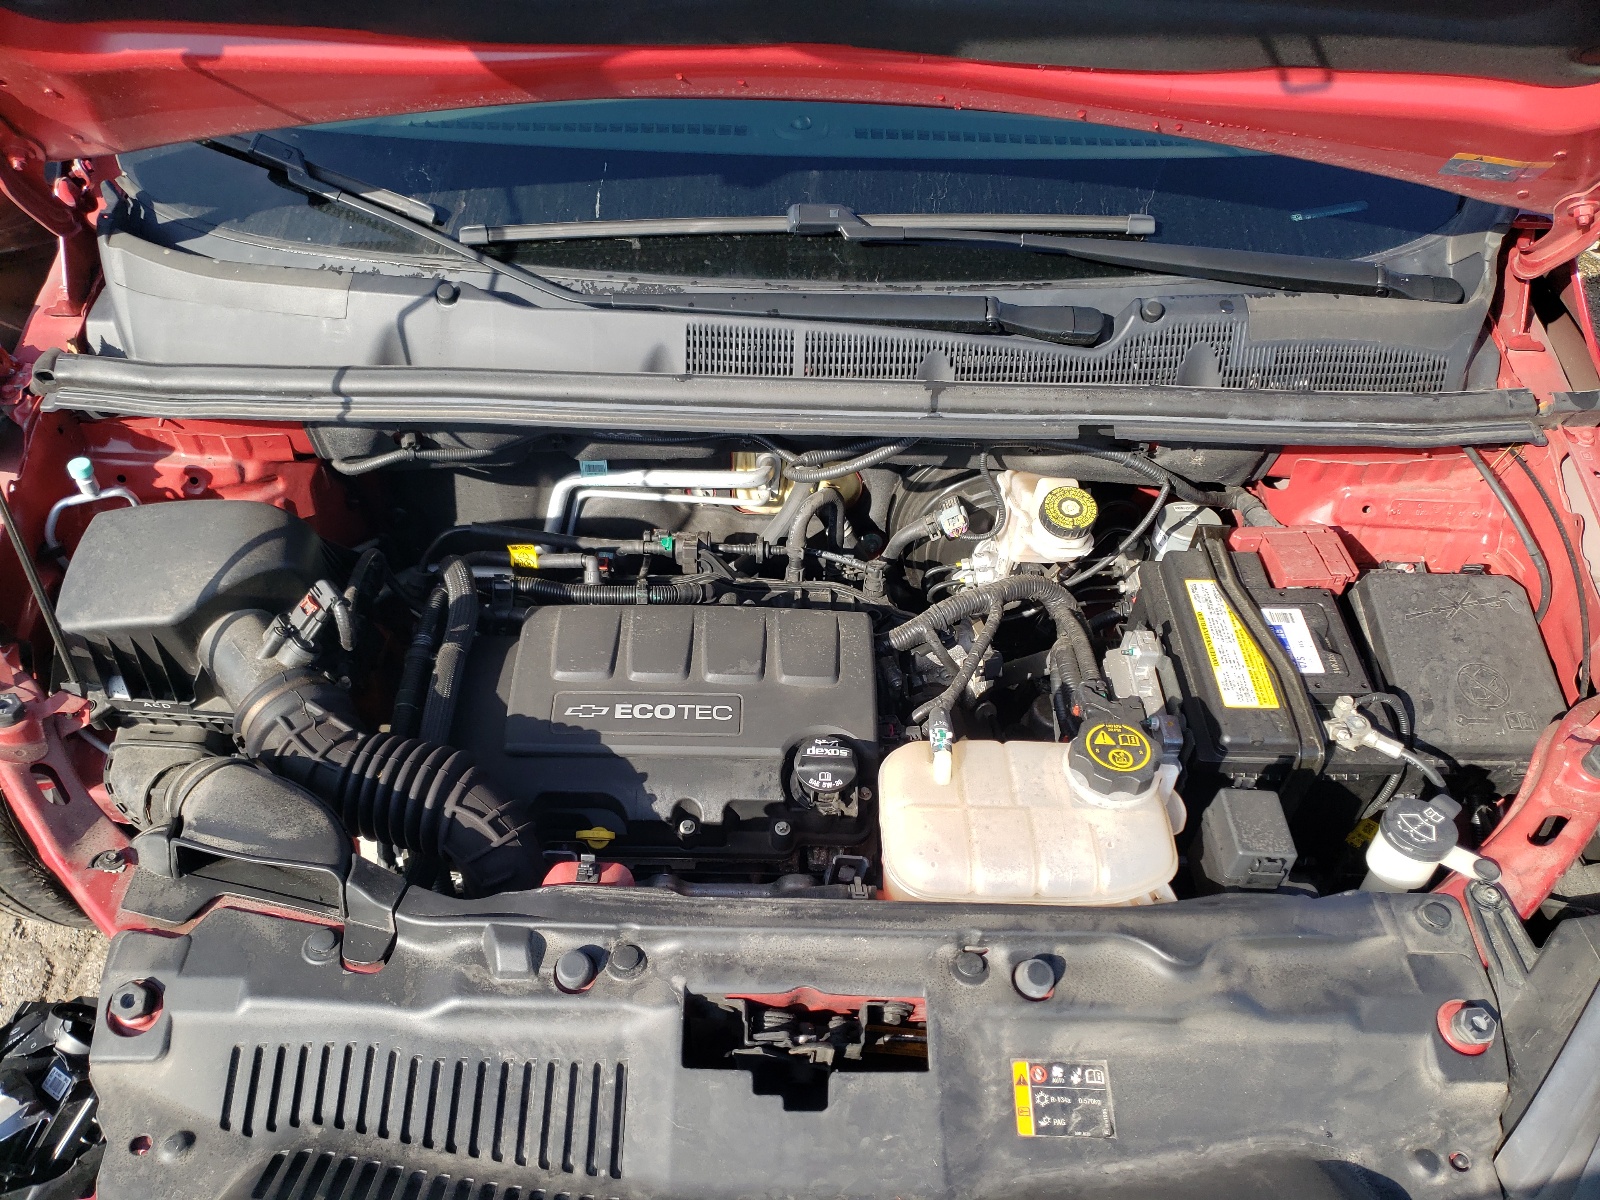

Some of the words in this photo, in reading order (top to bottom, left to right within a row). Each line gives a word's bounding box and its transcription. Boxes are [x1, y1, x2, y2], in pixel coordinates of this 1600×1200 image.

[614, 703, 733, 721] ECOTEC
[807, 746, 849, 756] dexos
[808, 778, 821, 787] SAE
[1050, 1096, 1071, 1104] R-134a
